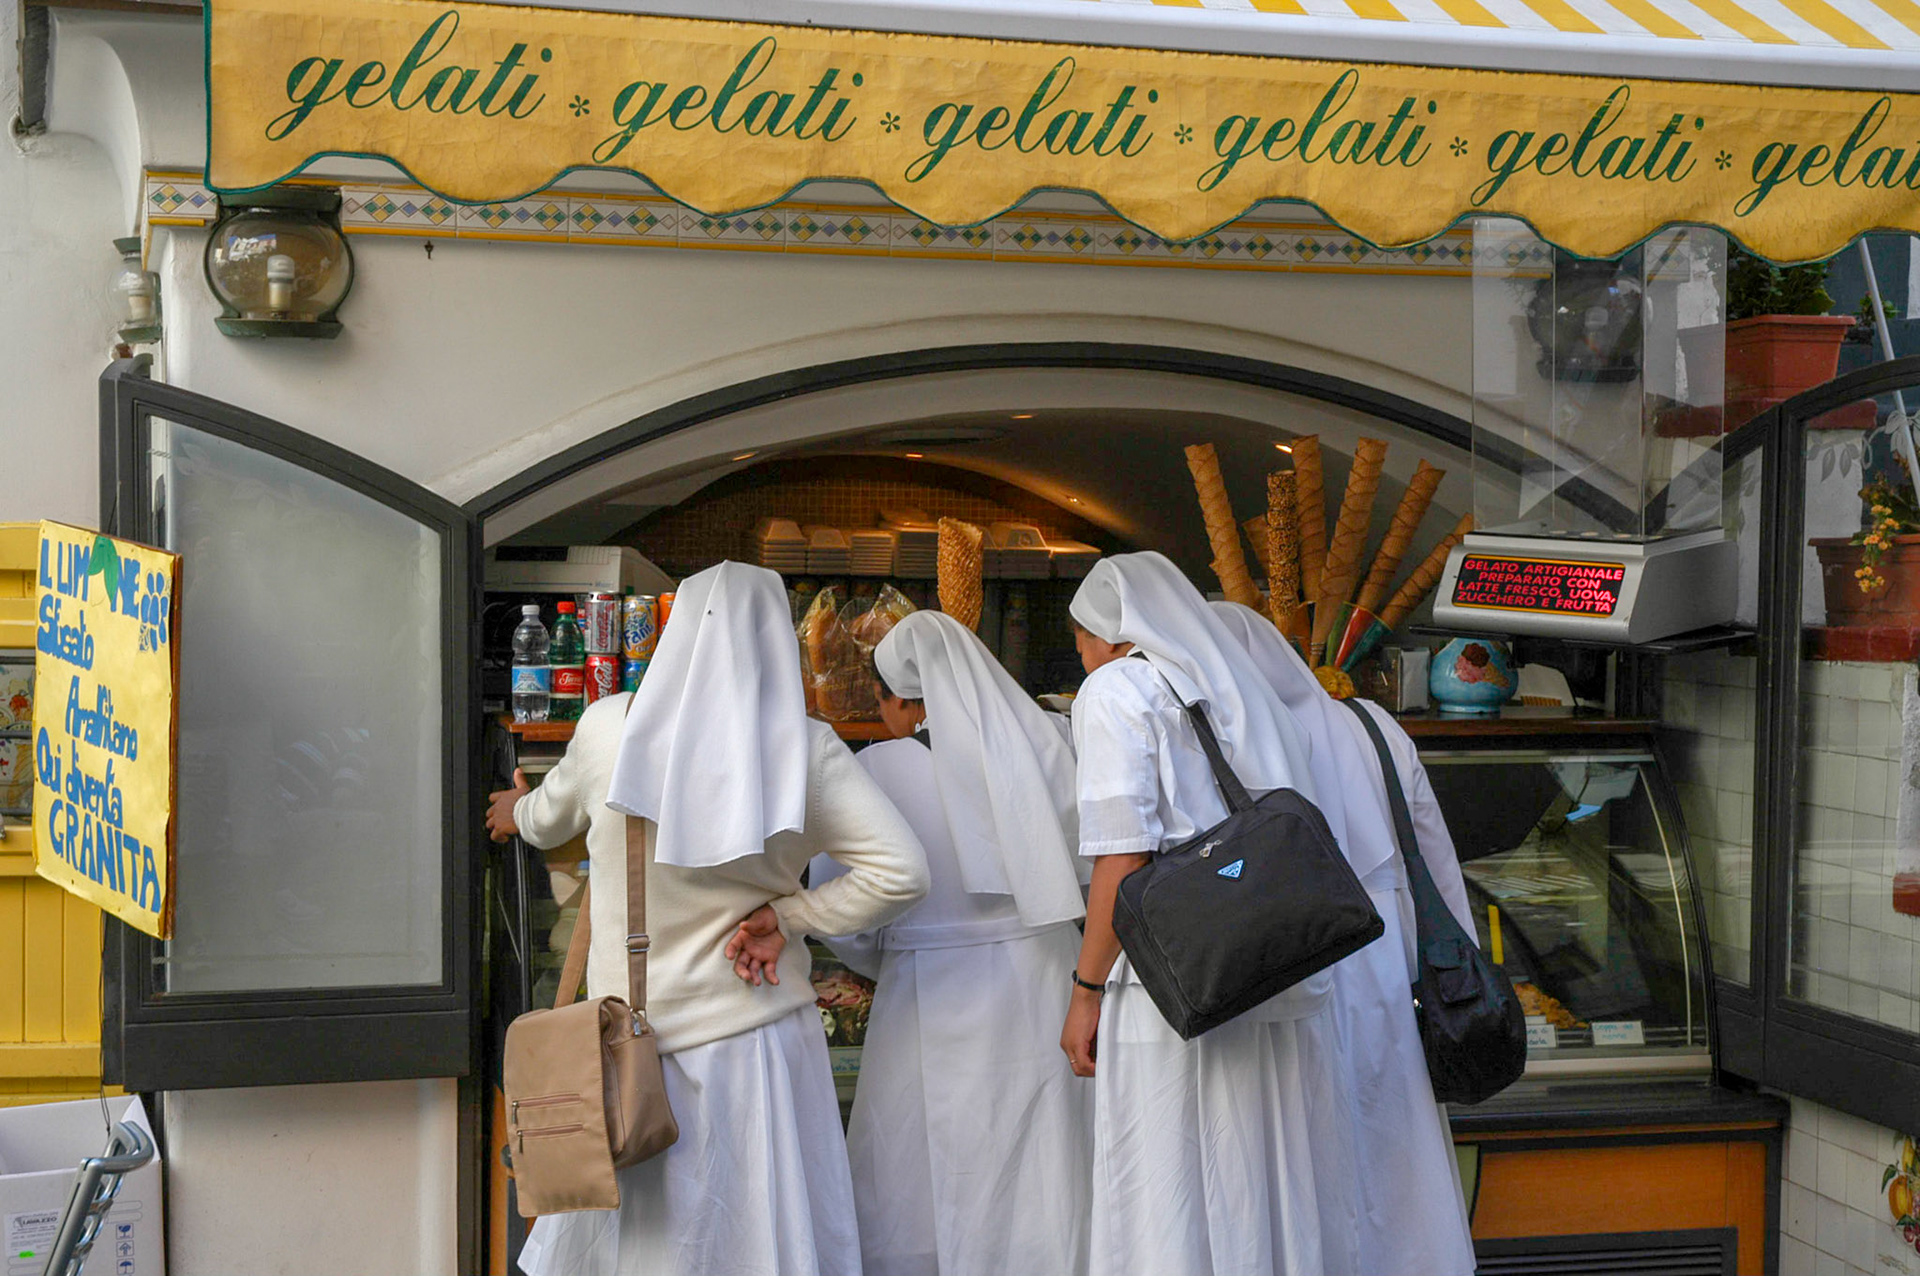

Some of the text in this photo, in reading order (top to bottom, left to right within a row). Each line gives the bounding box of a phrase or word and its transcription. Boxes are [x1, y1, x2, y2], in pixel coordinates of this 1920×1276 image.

[265, 9, 552, 141] gelati
[592, 36, 863, 164] gelati
[905, 56, 1158, 183] gelati
[1197, 68, 1437, 192] gelati
[1471, 84, 1704, 206] gelati
[1457, 580, 1617, 604] LATTE FRESCO, UOVA,
[1465, 560, 1623, 580] GELATO ARTIGIANALE
[1478, 571, 1602, 590] PREPARATO CON
[1456, 591, 1612, 613] ZUCCHERO E FRUTTA
[65, 675, 138, 763] Amalfitano
[37, 726, 124, 830] Qui diventa
[49, 798, 161, 914] GRANITA
